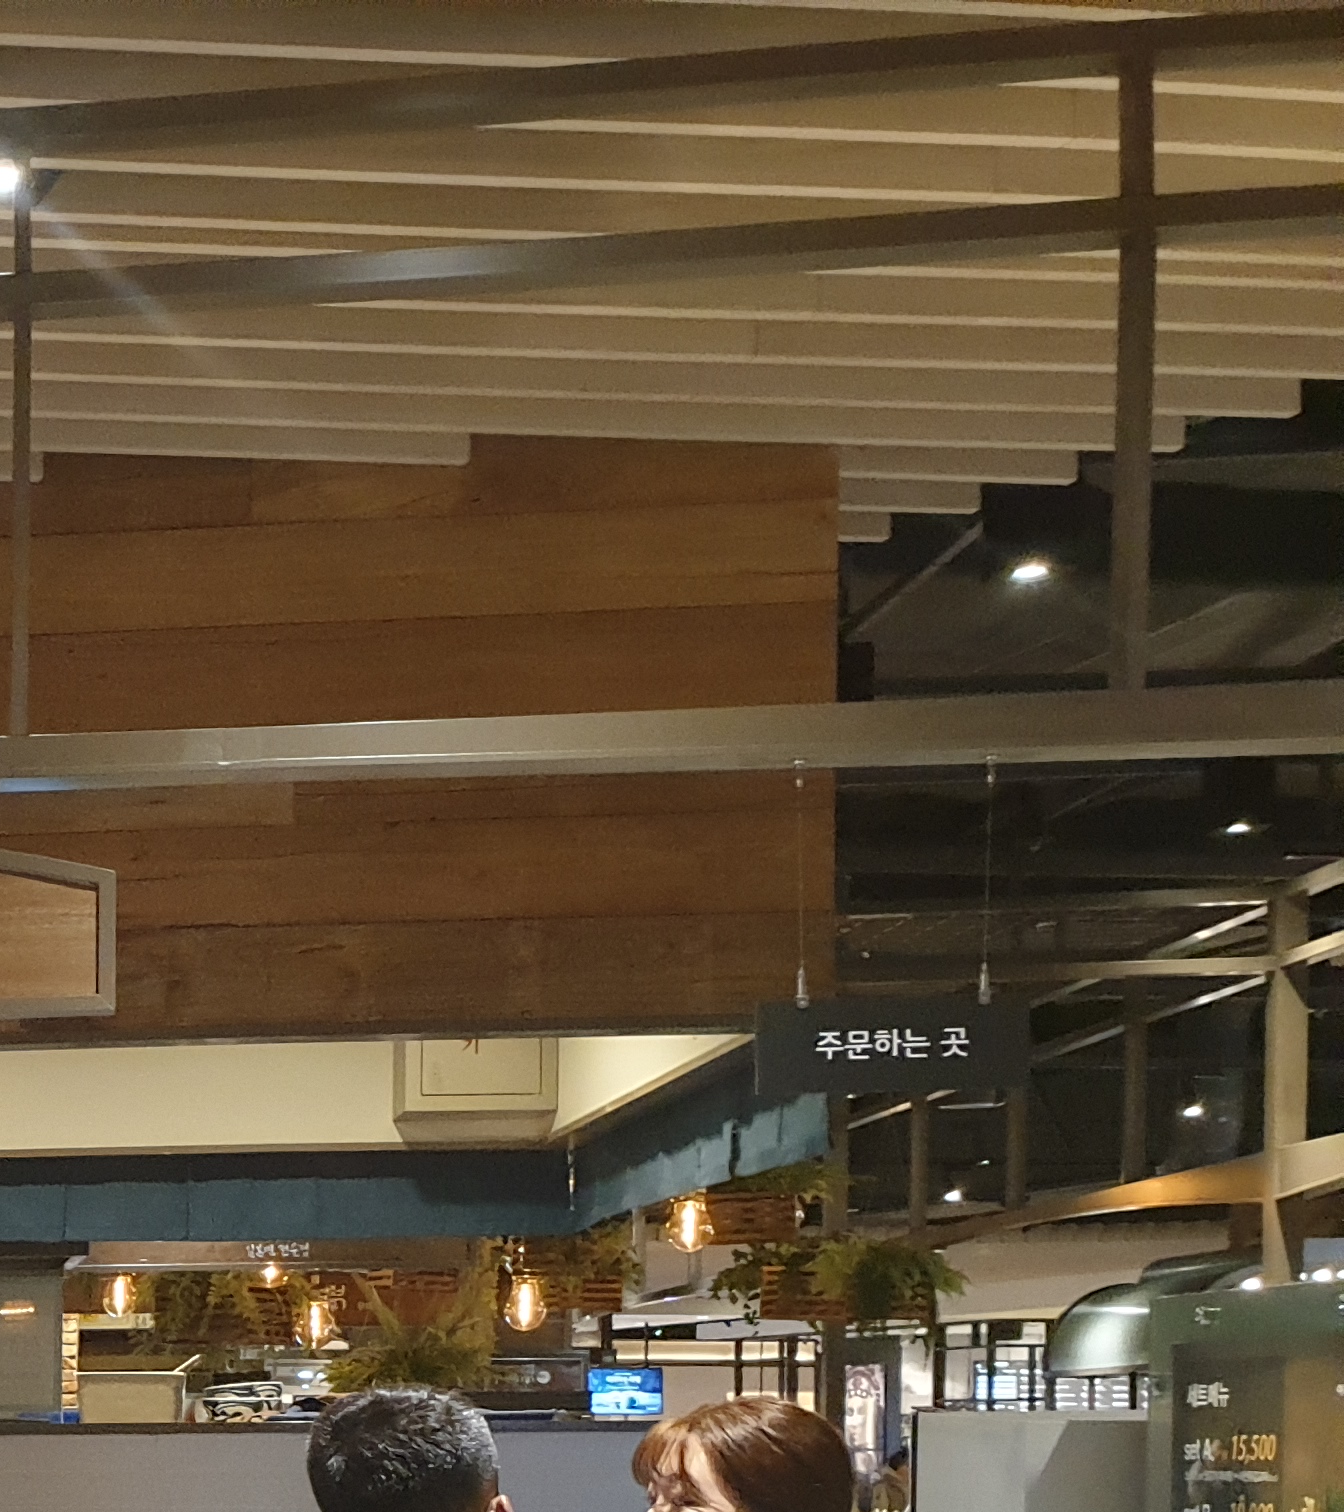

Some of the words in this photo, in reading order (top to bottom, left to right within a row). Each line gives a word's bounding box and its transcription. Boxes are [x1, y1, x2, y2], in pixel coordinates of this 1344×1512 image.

[815, 1029, 929, 1059] 주문하는
[940, 1027, 969, 1057] 곳
[1231, 1434, 1277, 1464] 15,500
